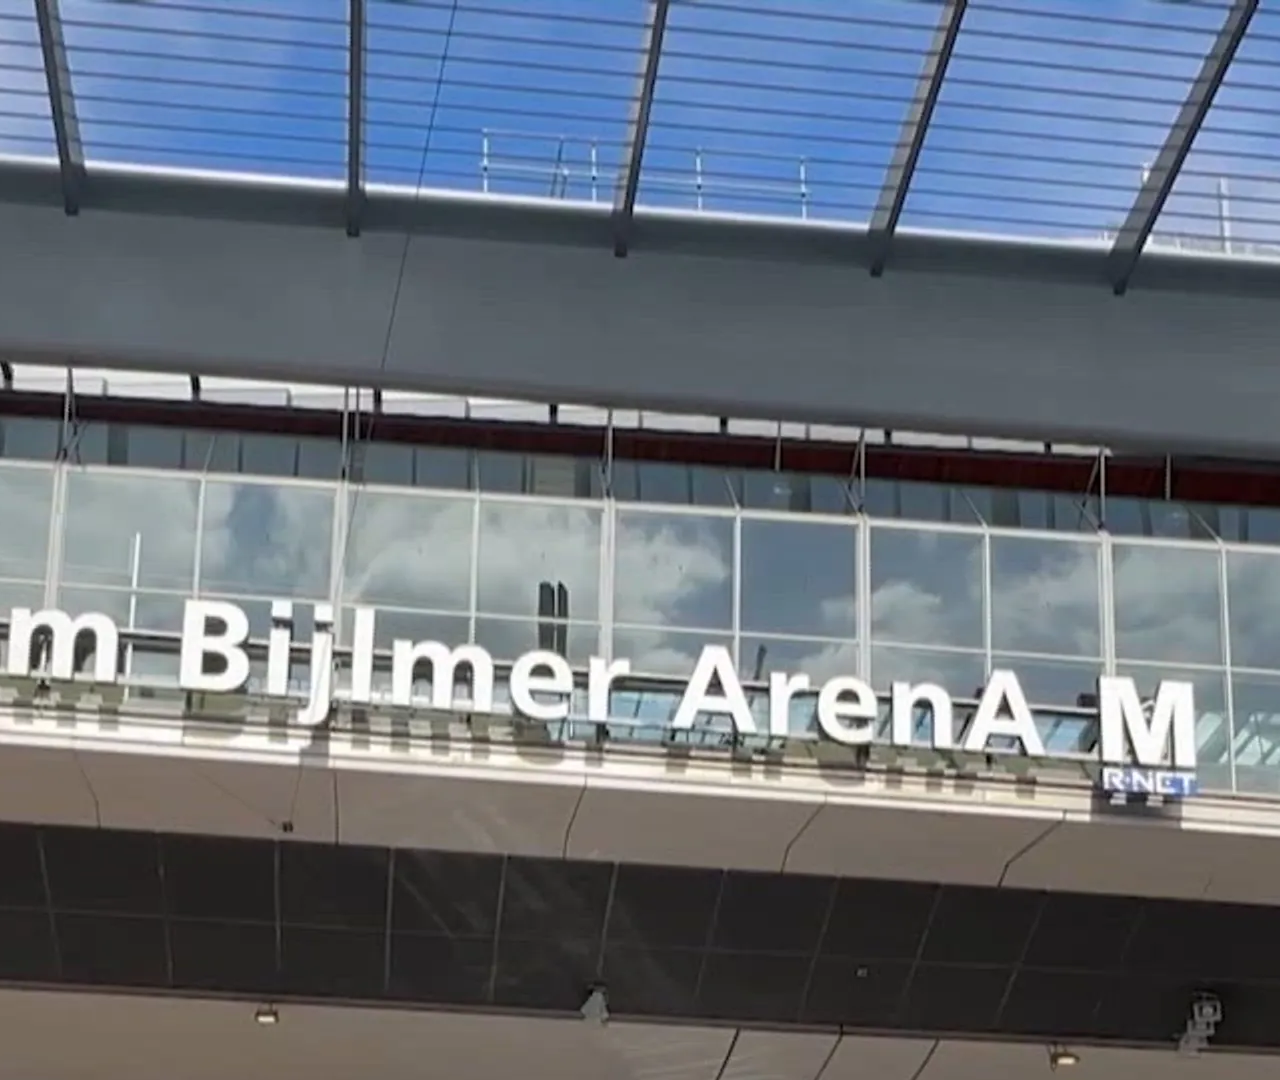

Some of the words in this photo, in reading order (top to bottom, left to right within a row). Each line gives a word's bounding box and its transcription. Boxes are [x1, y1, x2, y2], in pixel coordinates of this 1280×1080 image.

[178, 599, 630, 726] Bijlmer
[671, 644, 1046, 756] ArenA
[1099, 676, 1196, 768] M
